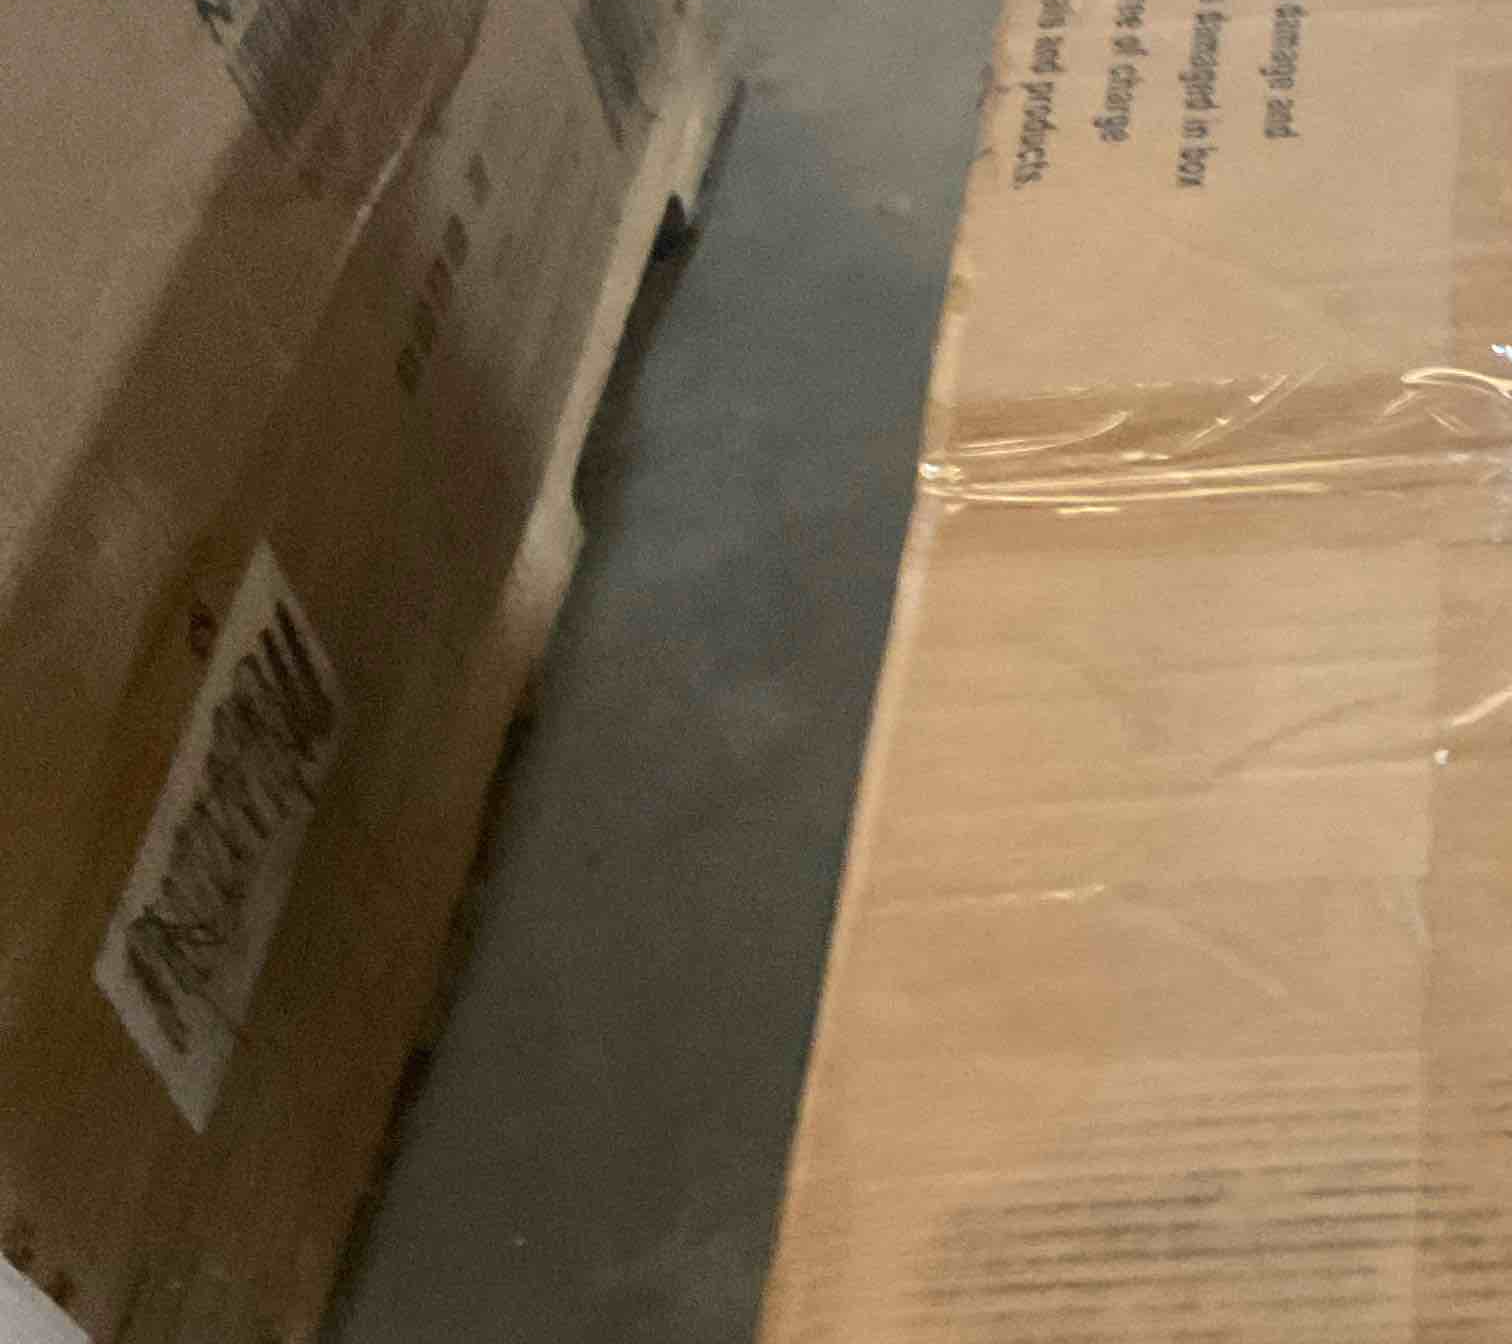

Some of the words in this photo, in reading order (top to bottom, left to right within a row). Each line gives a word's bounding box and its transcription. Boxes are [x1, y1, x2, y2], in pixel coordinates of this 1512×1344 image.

[1029, 36, 1067, 75] and
[1112, 34, 1150, 56] of
[1178, 10, 1232, 111] damaged
[1261, 3, 1309, 89] damage
[1092, 62, 1144, 144] charge
[1264, 97, 1301, 139] and
[1011, 80, 1058, 191] products.
[1183, 119, 1220, 140] in
[1175, 145, 1221, 189] box
